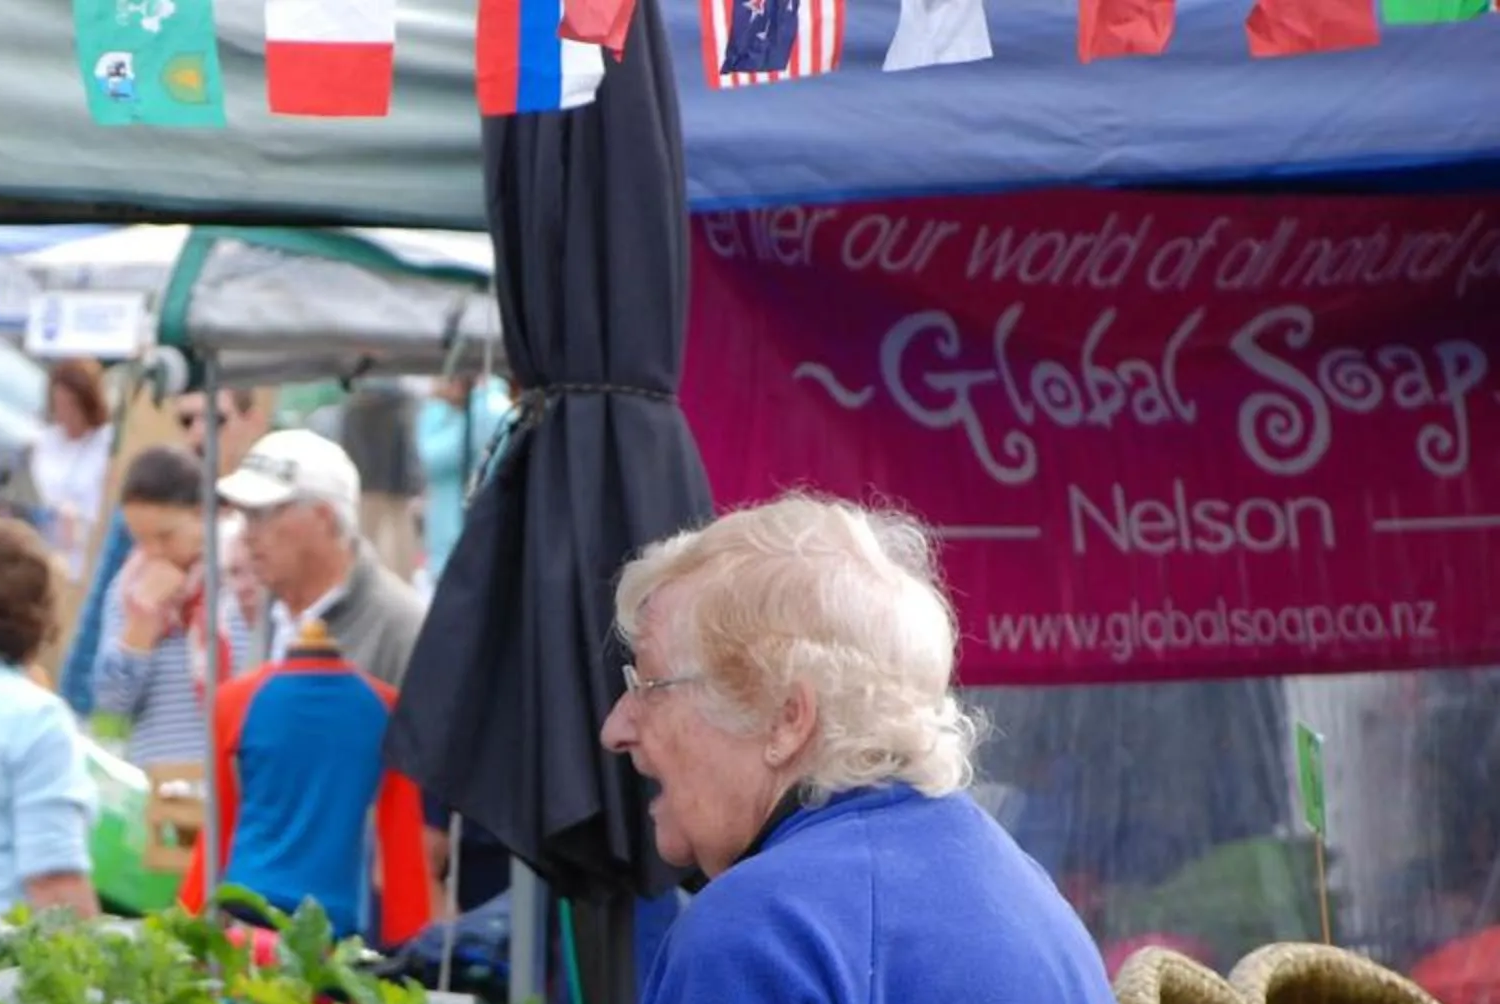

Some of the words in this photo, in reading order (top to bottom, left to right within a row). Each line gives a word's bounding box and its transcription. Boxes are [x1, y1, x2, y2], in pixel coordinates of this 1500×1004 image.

[840, 212, 961, 274] our
[965, 211, 1156, 290] world
[1146, 216, 1232, 290] of
[1214, 216, 1299, 290] all
[1279, 209, 1486, 288] natural
[879, 302, 1206, 485] Global
[1228, 304, 1488, 477] Soap
[1068, 477, 1336, 555] Nelson
[986, 598, 1439, 663] www.globalsoap.co.nz
